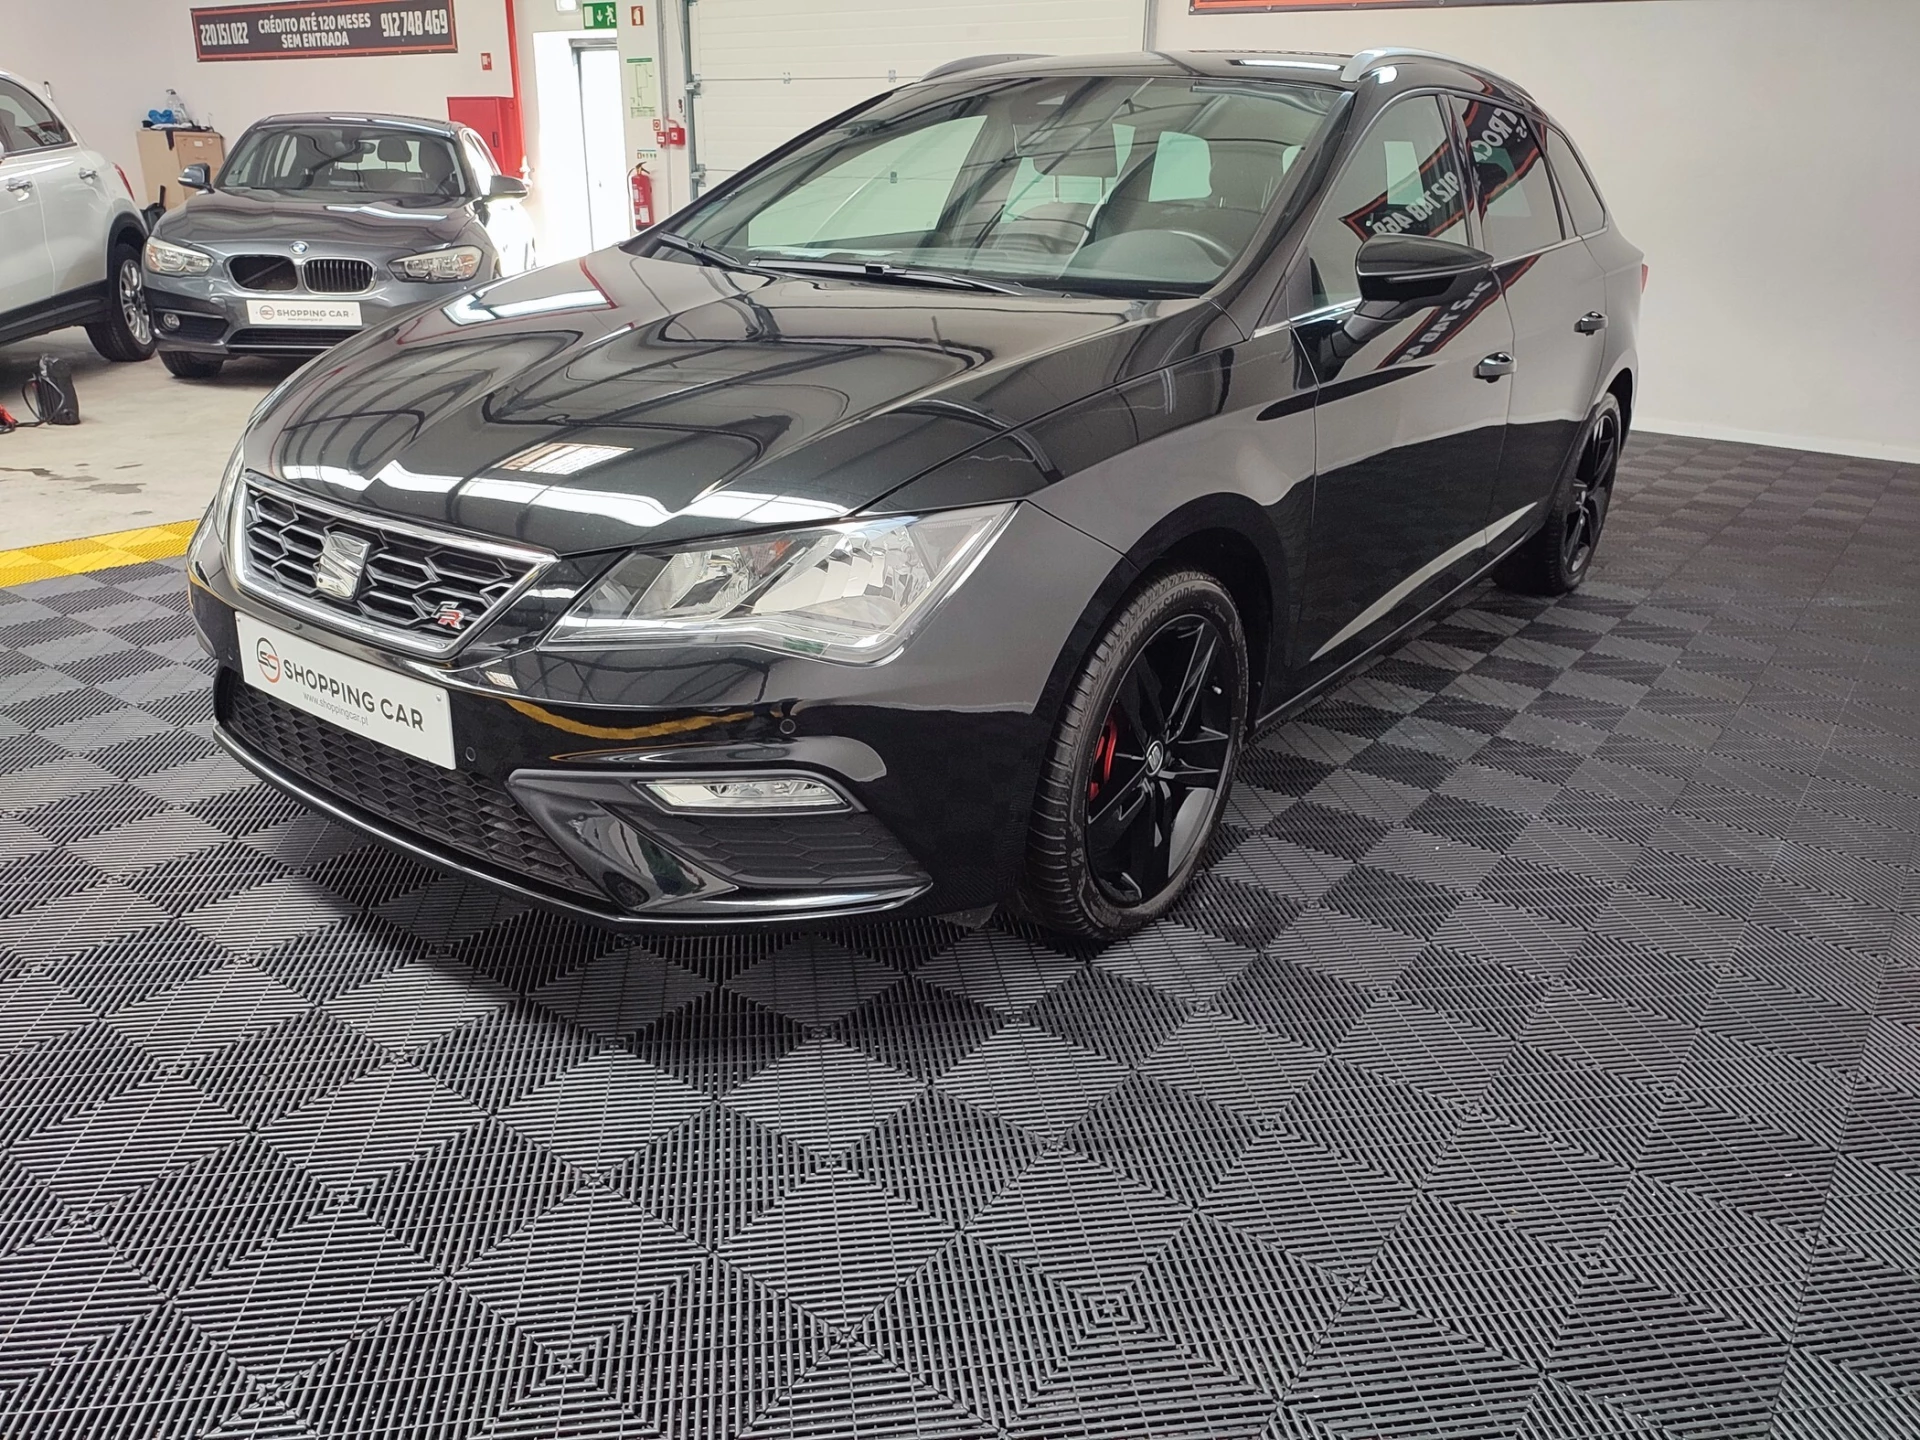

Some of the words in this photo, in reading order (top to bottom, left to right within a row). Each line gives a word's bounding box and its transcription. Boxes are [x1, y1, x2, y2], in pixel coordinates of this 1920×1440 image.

[200, 24, 217, 46] 220
[217, 23, 232, 45] 151
[231, 22, 249, 45] 022
[258, 15, 297, 34] CRÉDITO
[299, 12, 317, 32] ATÉ
[318, 16, 336, 31] 120
[337, 13, 371, 29] MESES
[380, 13, 401, 37] 912
[401, 11, 423, 36] 748
[424, 9, 448, 35] 469
[281, 34, 303, 49] SEM
[303, 31, 349, 48] ENTRADA
[276, 309, 327, 317] SHOPPING
[328, 310, 349, 318] CAR
[431, 600, 465, 629] FR
[284, 659, 375, 713] SHOPPING
[380, 698, 424, 732] CAR
